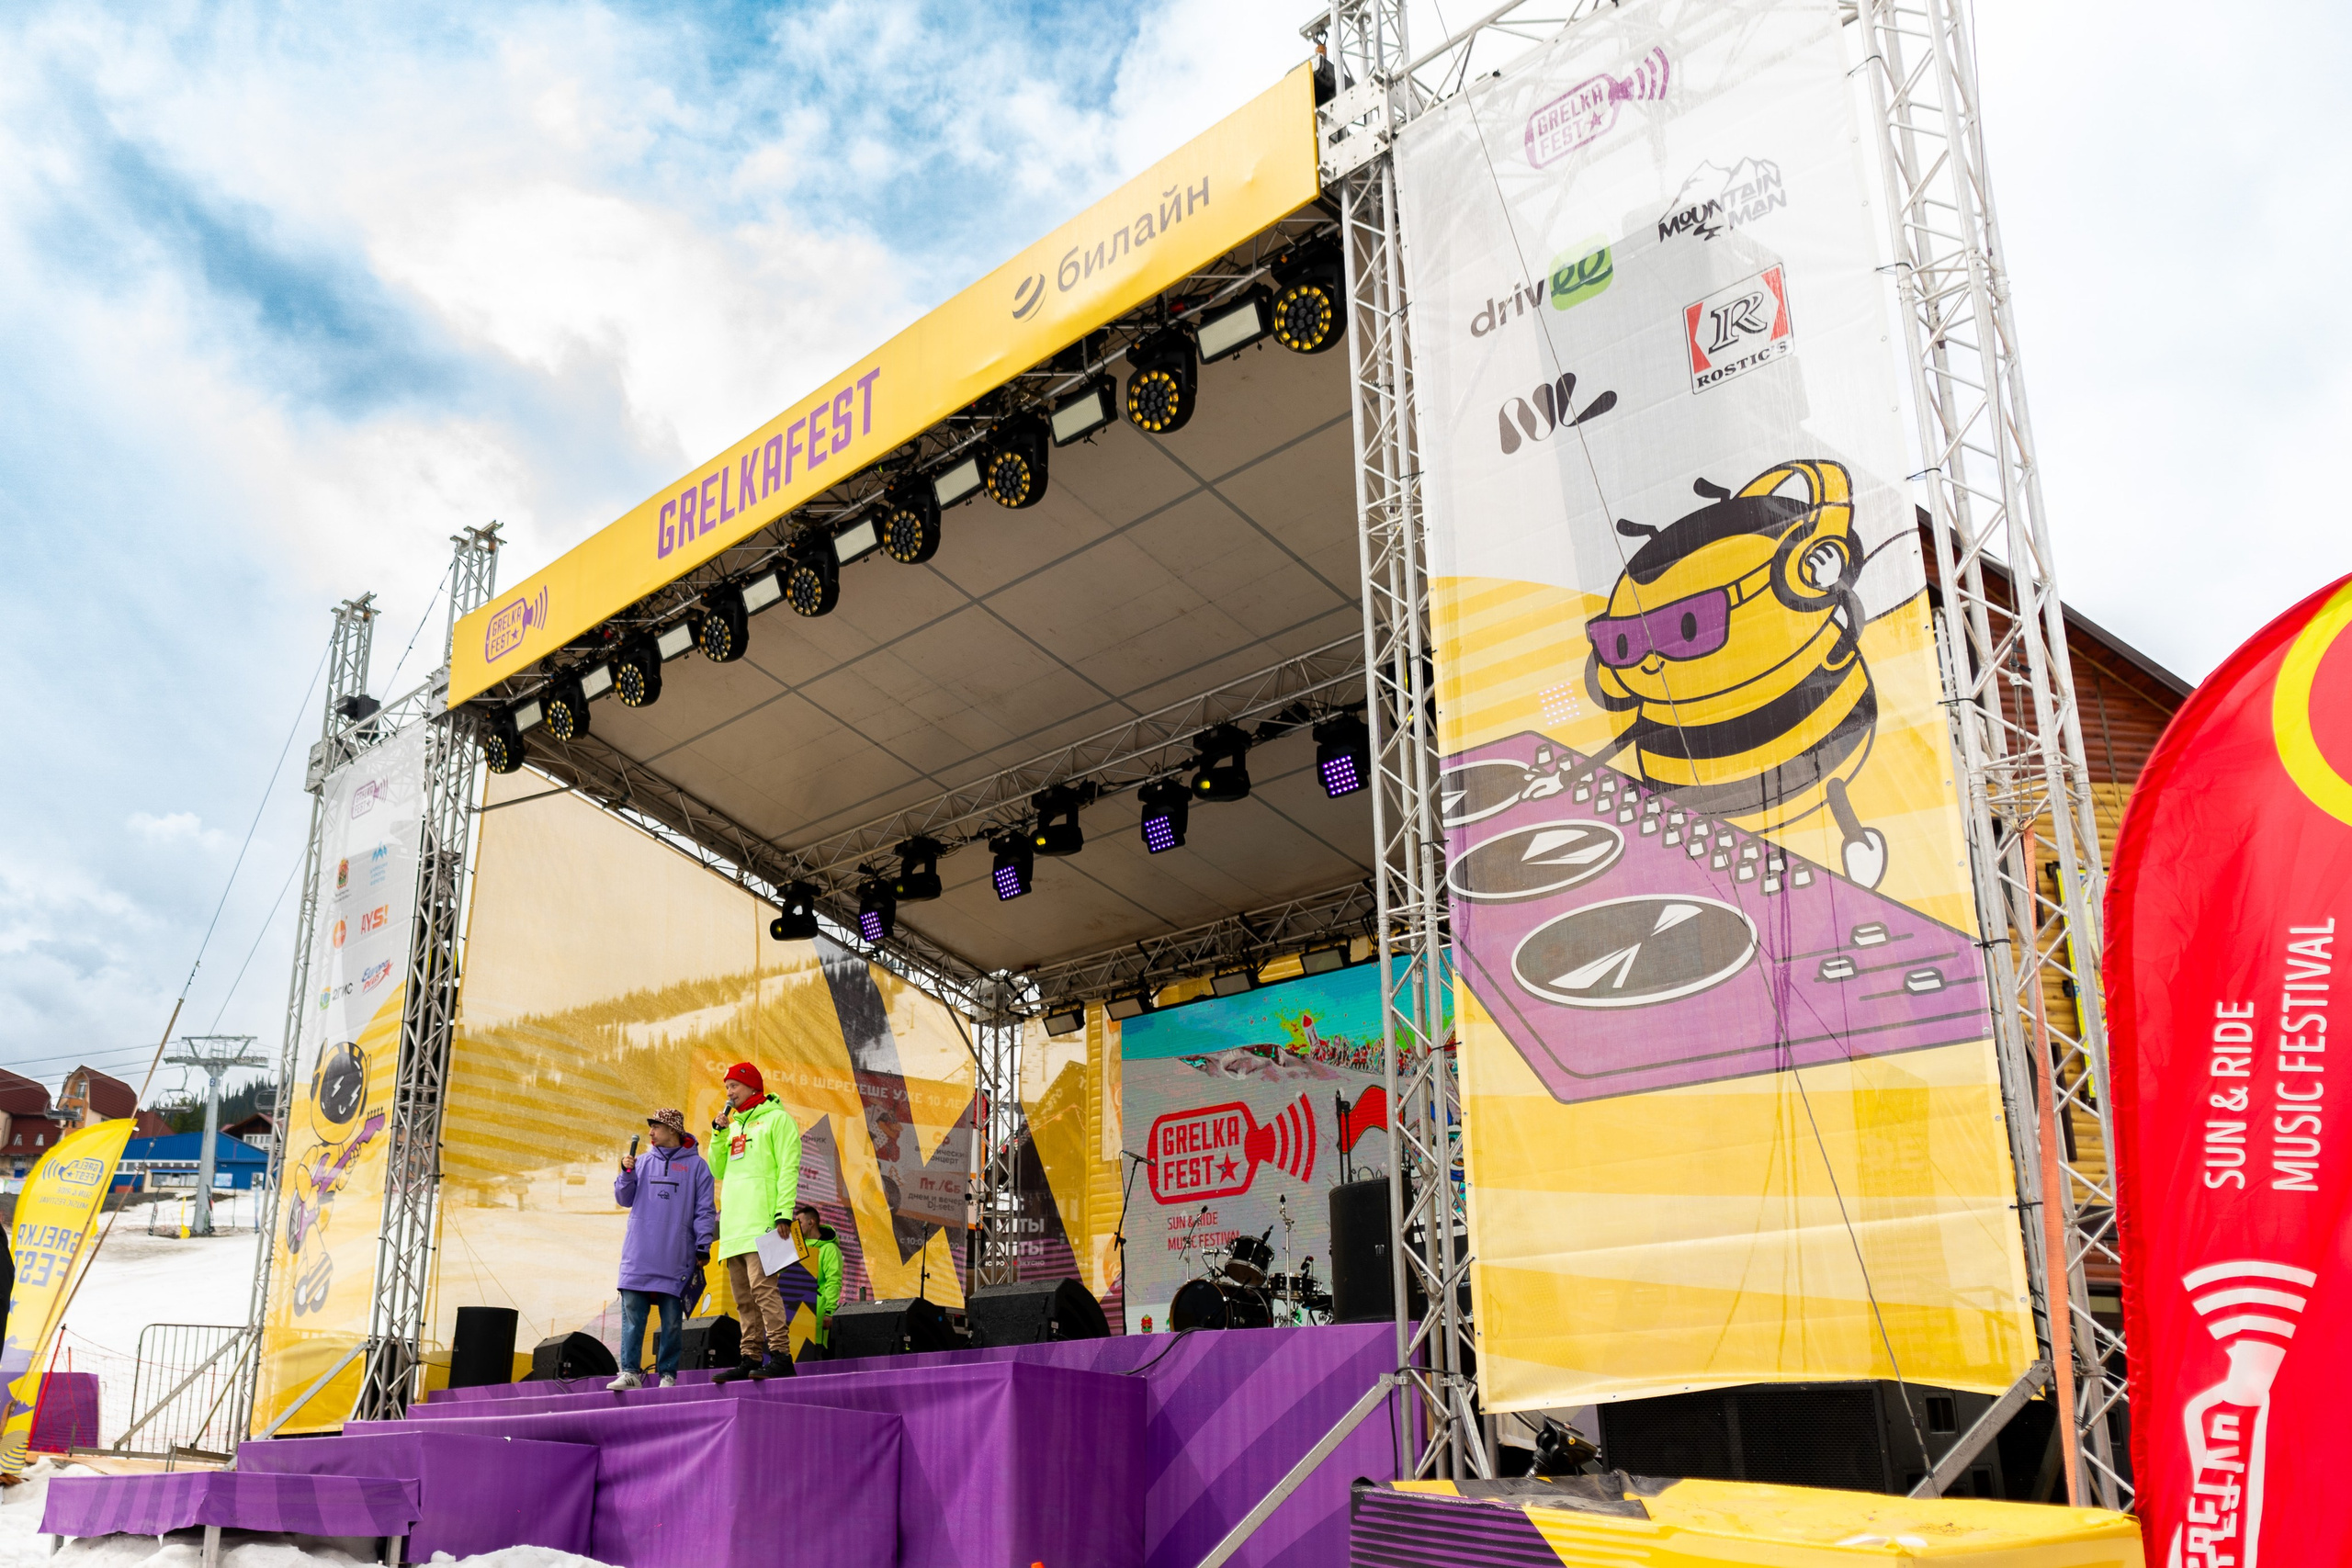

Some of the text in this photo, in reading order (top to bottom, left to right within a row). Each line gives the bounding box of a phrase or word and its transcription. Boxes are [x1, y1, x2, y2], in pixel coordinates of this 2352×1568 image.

[1537, 84, 1604, 137] GRELKA
[1540, 120, 1584, 158] FEST
[1657, 168, 1782, 243] MOUNTAIN
[1728, 189, 1787, 231] MAN
[1058, 175, 1210, 292] билайн
[1470, 243, 1614, 339] drivee
[1696, 340, 1789, 389] ROSTIC'S
[658, 367, 881, 560] GRELKAFEST
[492, 604, 523, 636] GRELKA
[490, 631, 512, 657] FEST
[2272, 917, 2335, 1191] MUSIC FESTIVAL
[813, 1077, 888, 1098] ШЕРЕГЕШЕ
[2204, 999, 2256, 1190] SUN & RIDE
[1161, 1115, 1240, 1156] GRELKA
[1163, 1155, 1215, 1191] FEST
[1168, 1215, 1186, 1231] SUN
[1168, 1235, 1198, 1251] MUC
